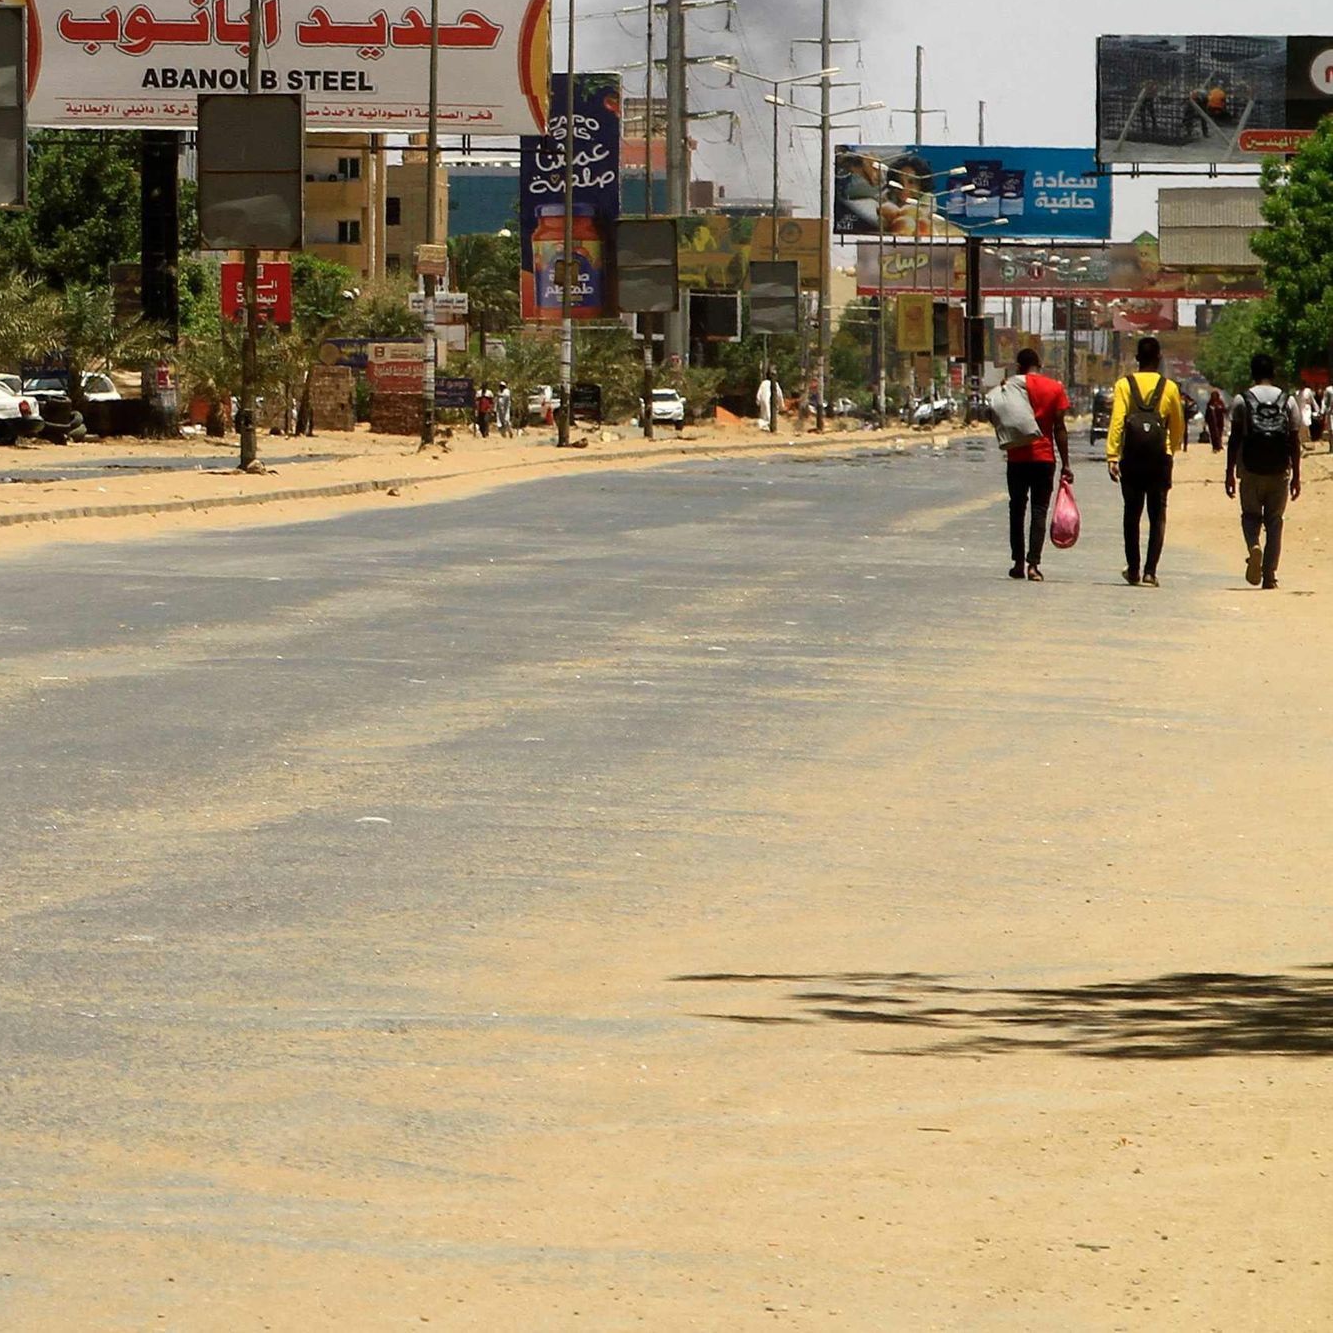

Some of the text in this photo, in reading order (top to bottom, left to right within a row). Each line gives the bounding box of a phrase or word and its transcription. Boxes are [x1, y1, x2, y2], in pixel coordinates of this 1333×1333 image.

[296, 6, 503, 60] حديد
[287, 71, 374, 91] STEEL
[162, 103, 190, 116] شركة
[358, 107, 412, 119] السودانية
[465, 109, 493, 120] فخر
[1033, 169, 1098, 191] سعادة
[1035, 191, 1096, 214] صافية
